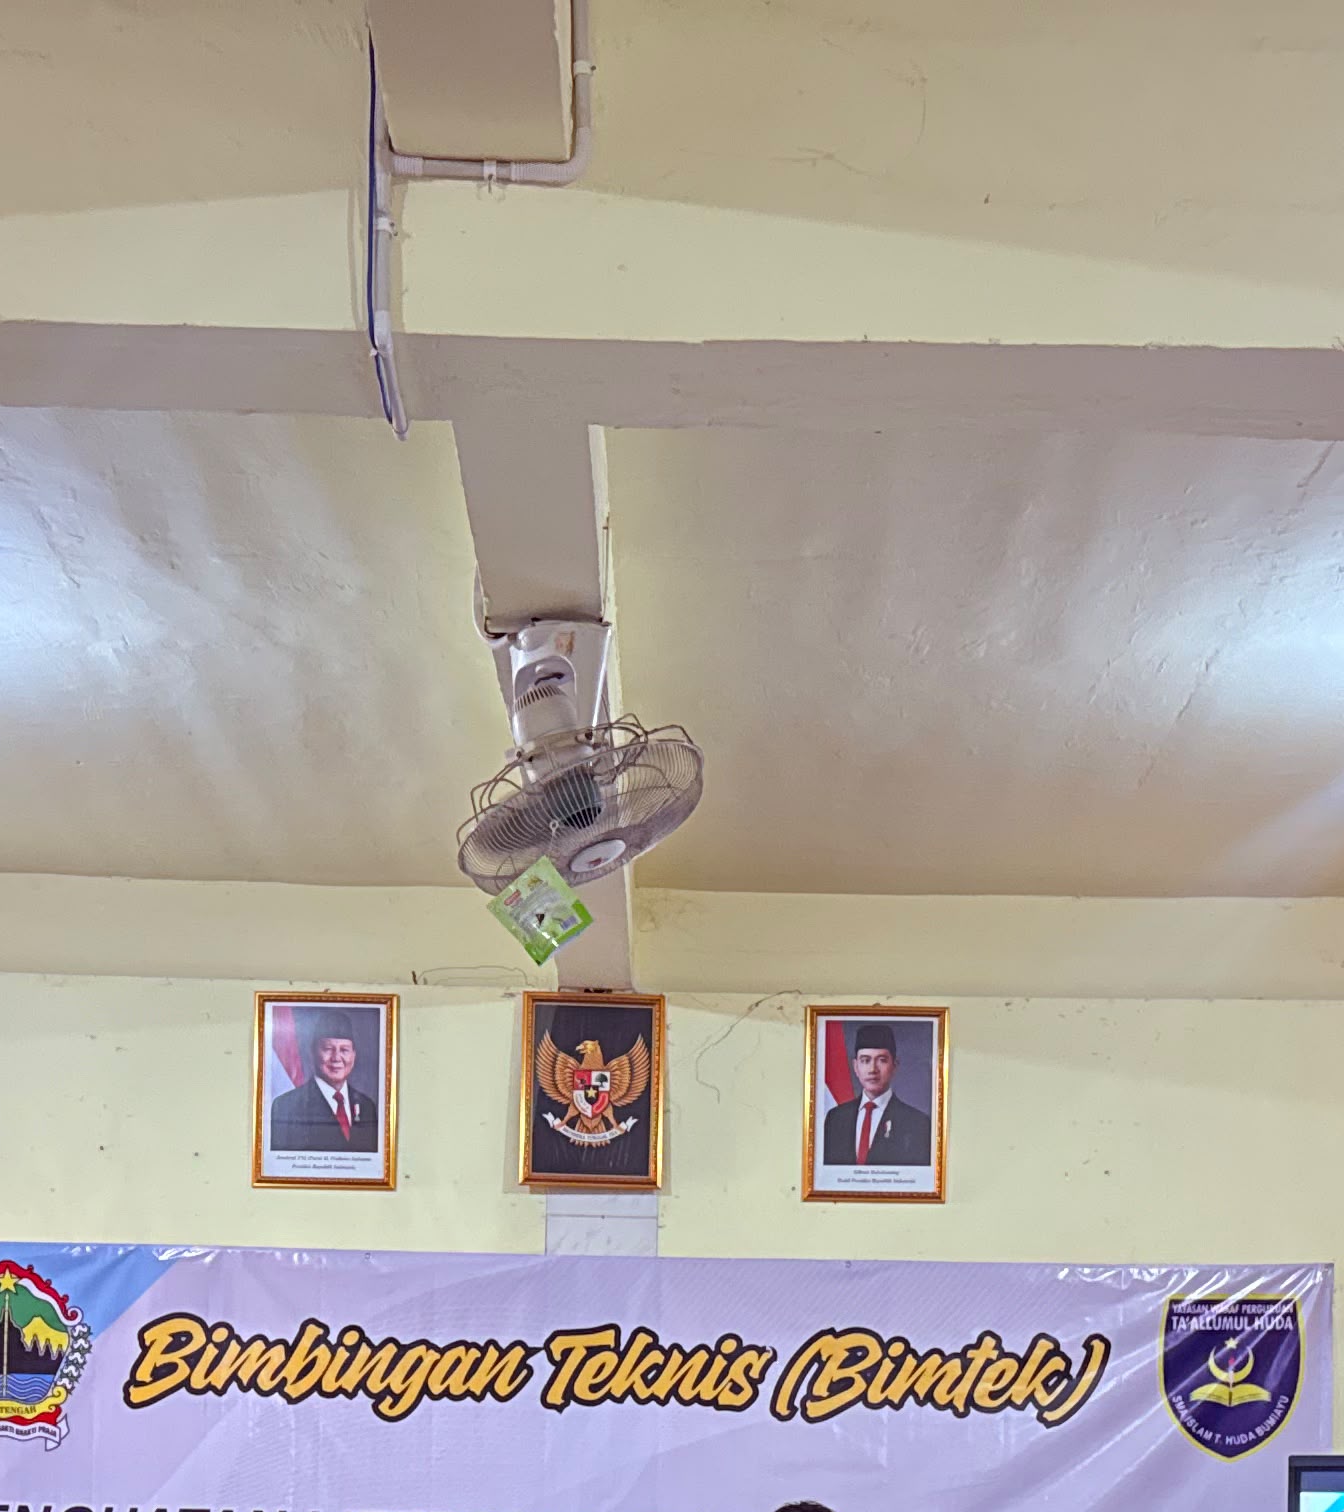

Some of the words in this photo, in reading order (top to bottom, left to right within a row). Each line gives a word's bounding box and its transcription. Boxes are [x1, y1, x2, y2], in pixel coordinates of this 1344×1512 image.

[1254, 1315, 1294, 1331] HUDA
[123, 1312, 542, 1422] Bimbingan
[541, 1323, 777, 1413] Teknis
[770, 1327, 1111, 1428] (Bimtek)
[1224, 1431, 1257, 1446] HUDA
[1254, 1395, 1290, 1437] BUMIAYU
